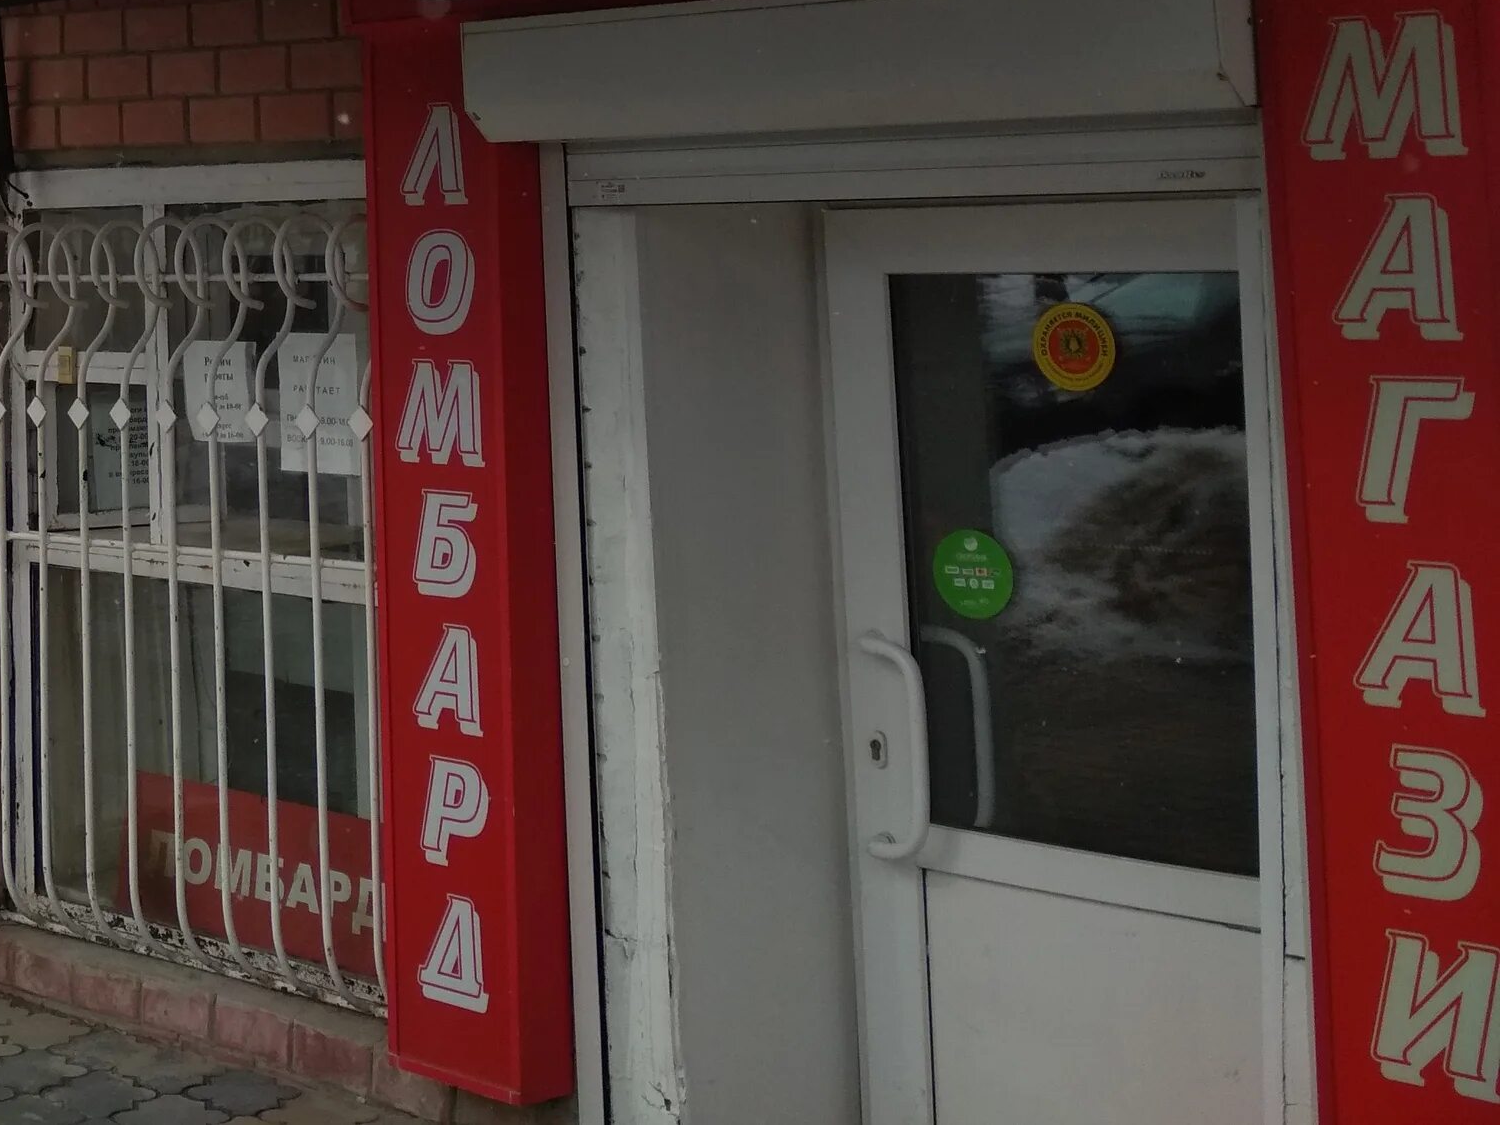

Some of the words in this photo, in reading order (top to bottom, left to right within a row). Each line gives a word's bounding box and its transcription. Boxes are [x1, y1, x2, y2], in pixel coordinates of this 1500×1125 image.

[292, 384, 342, 396] РАТАЕТ
[396, 102, 490, 1012] ЛОМБАРД
[149, 829, 387, 942] ЛОМБАРД
